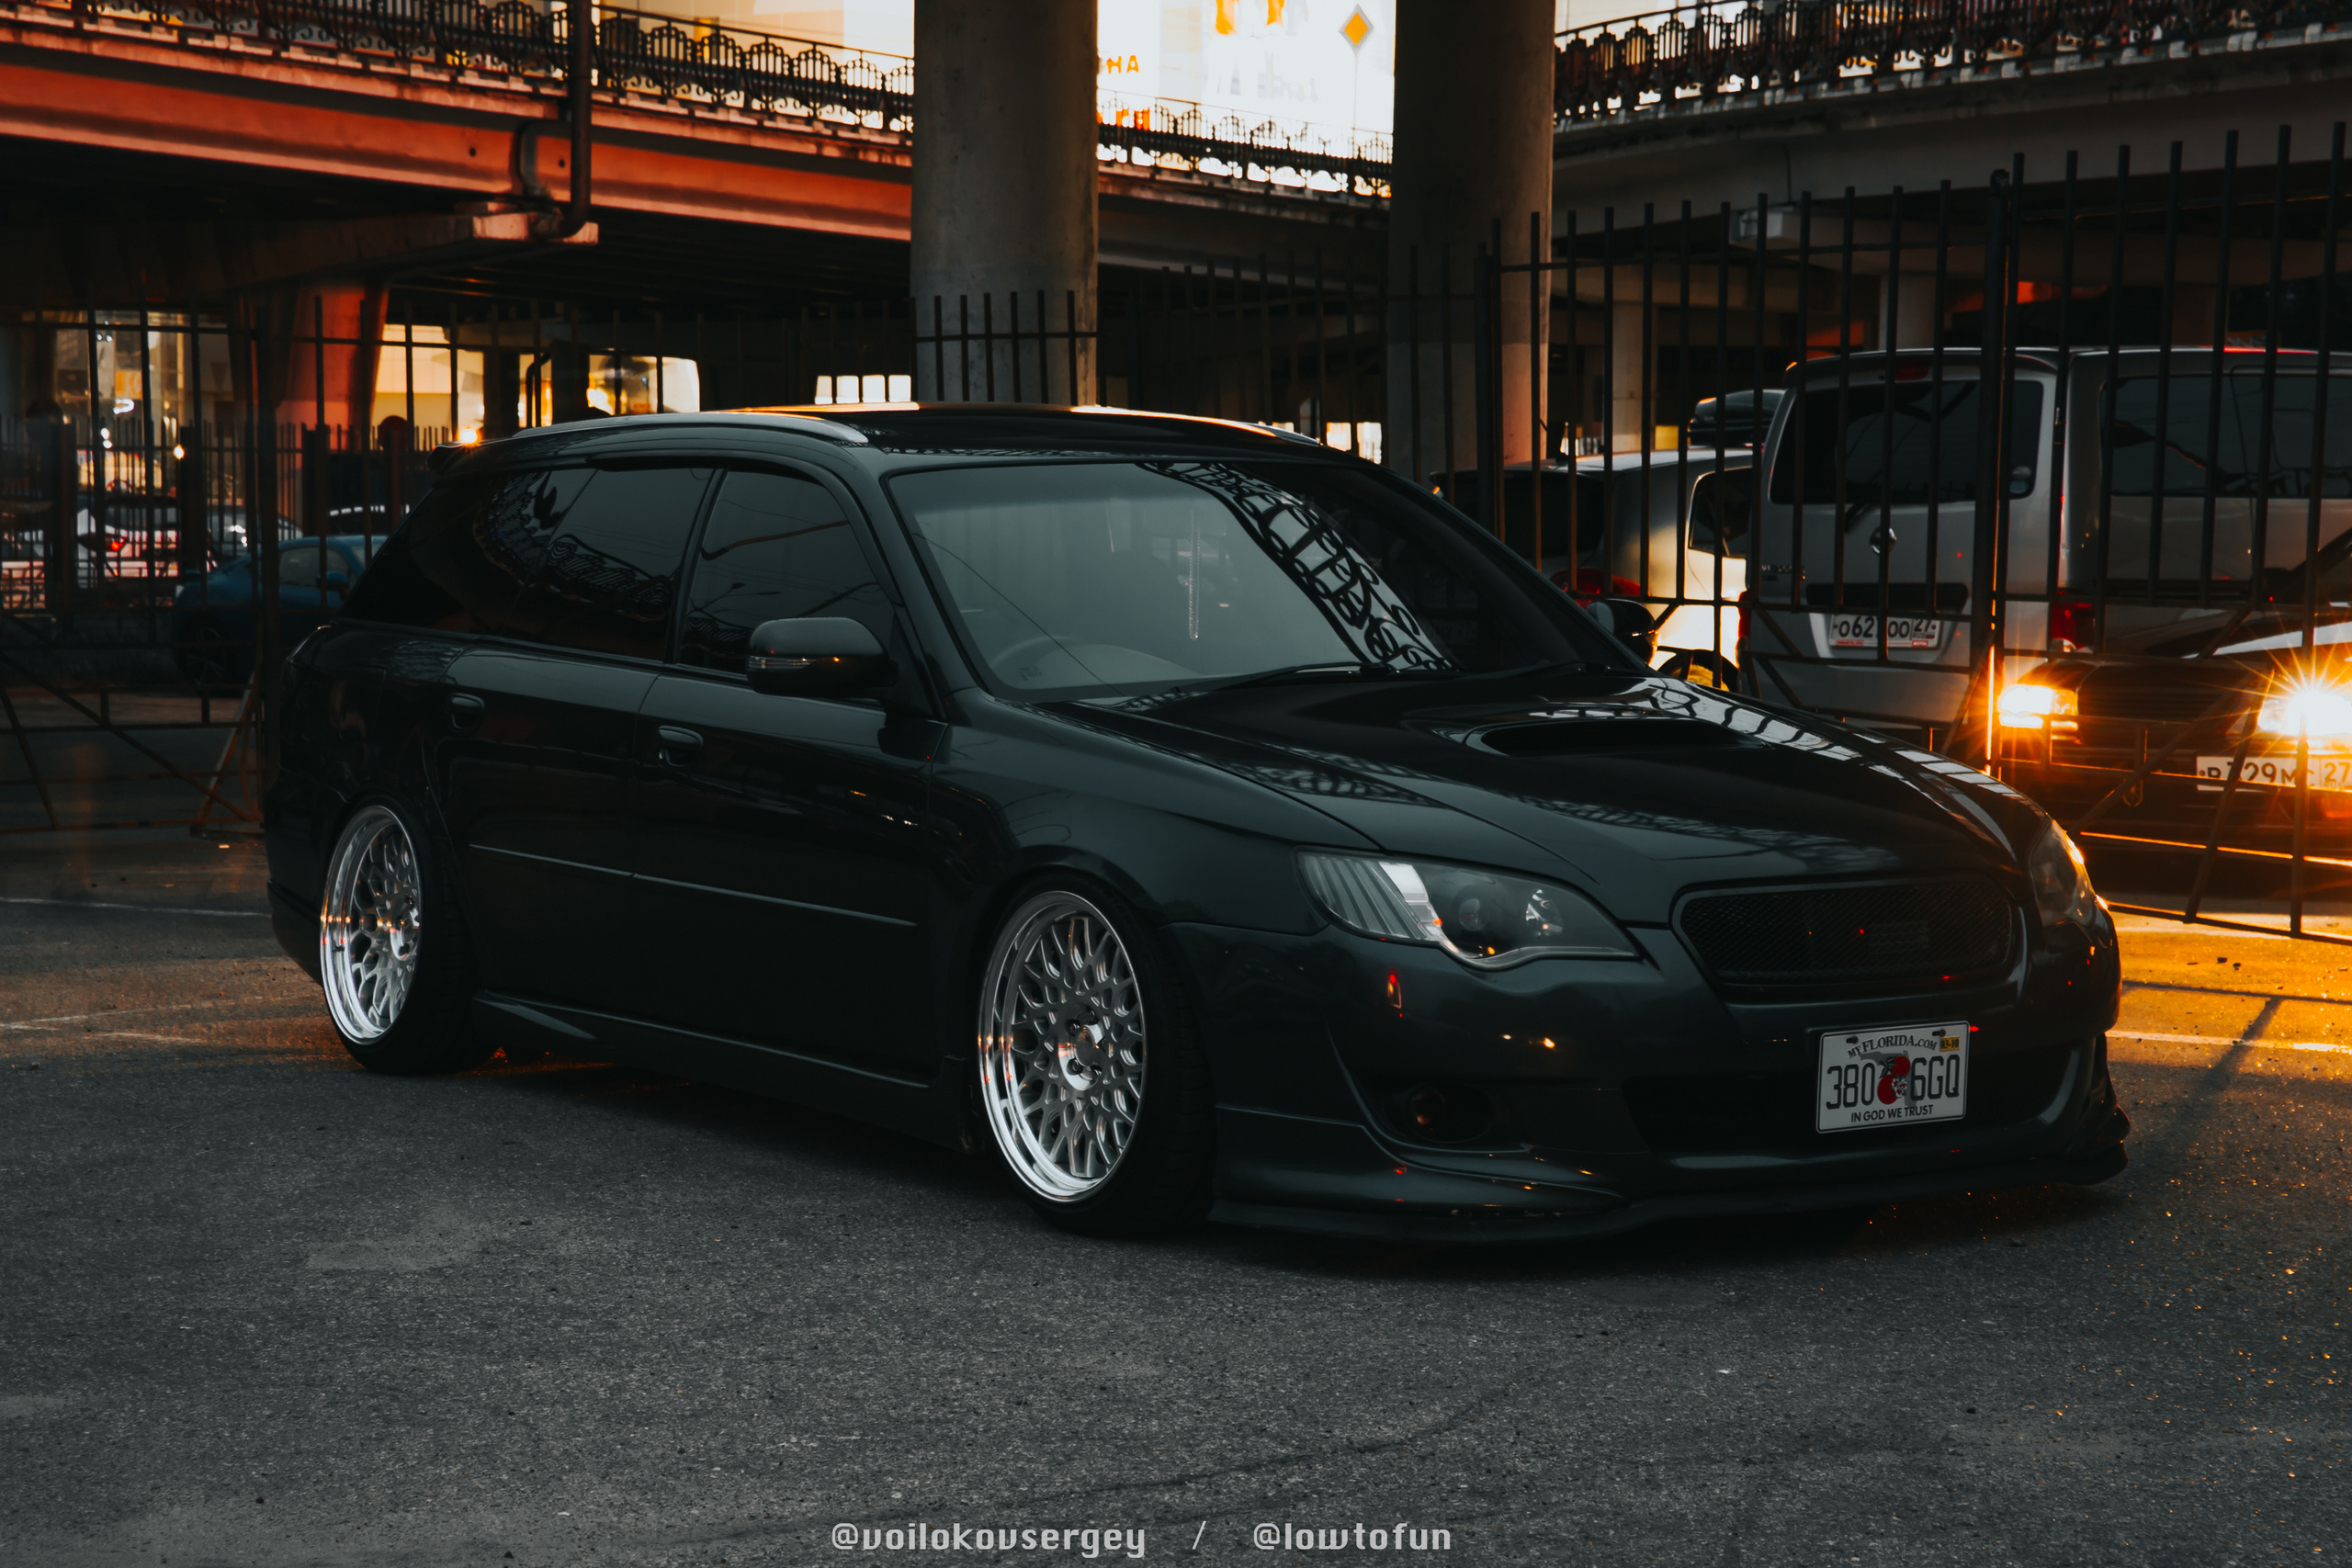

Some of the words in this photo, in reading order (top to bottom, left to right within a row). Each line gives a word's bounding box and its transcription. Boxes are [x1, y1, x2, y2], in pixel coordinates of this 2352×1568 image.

[2324, 761, 2351, 783] 27
[1826, 1062, 1876, 1110] 380
[1850, 1111, 1861, 1122] IN
[1863, 1109, 1885, 1122] GOD
[1887, 1106, 1902, 1119] WE
[1904, 1104, 1934, 1117] TRUST
